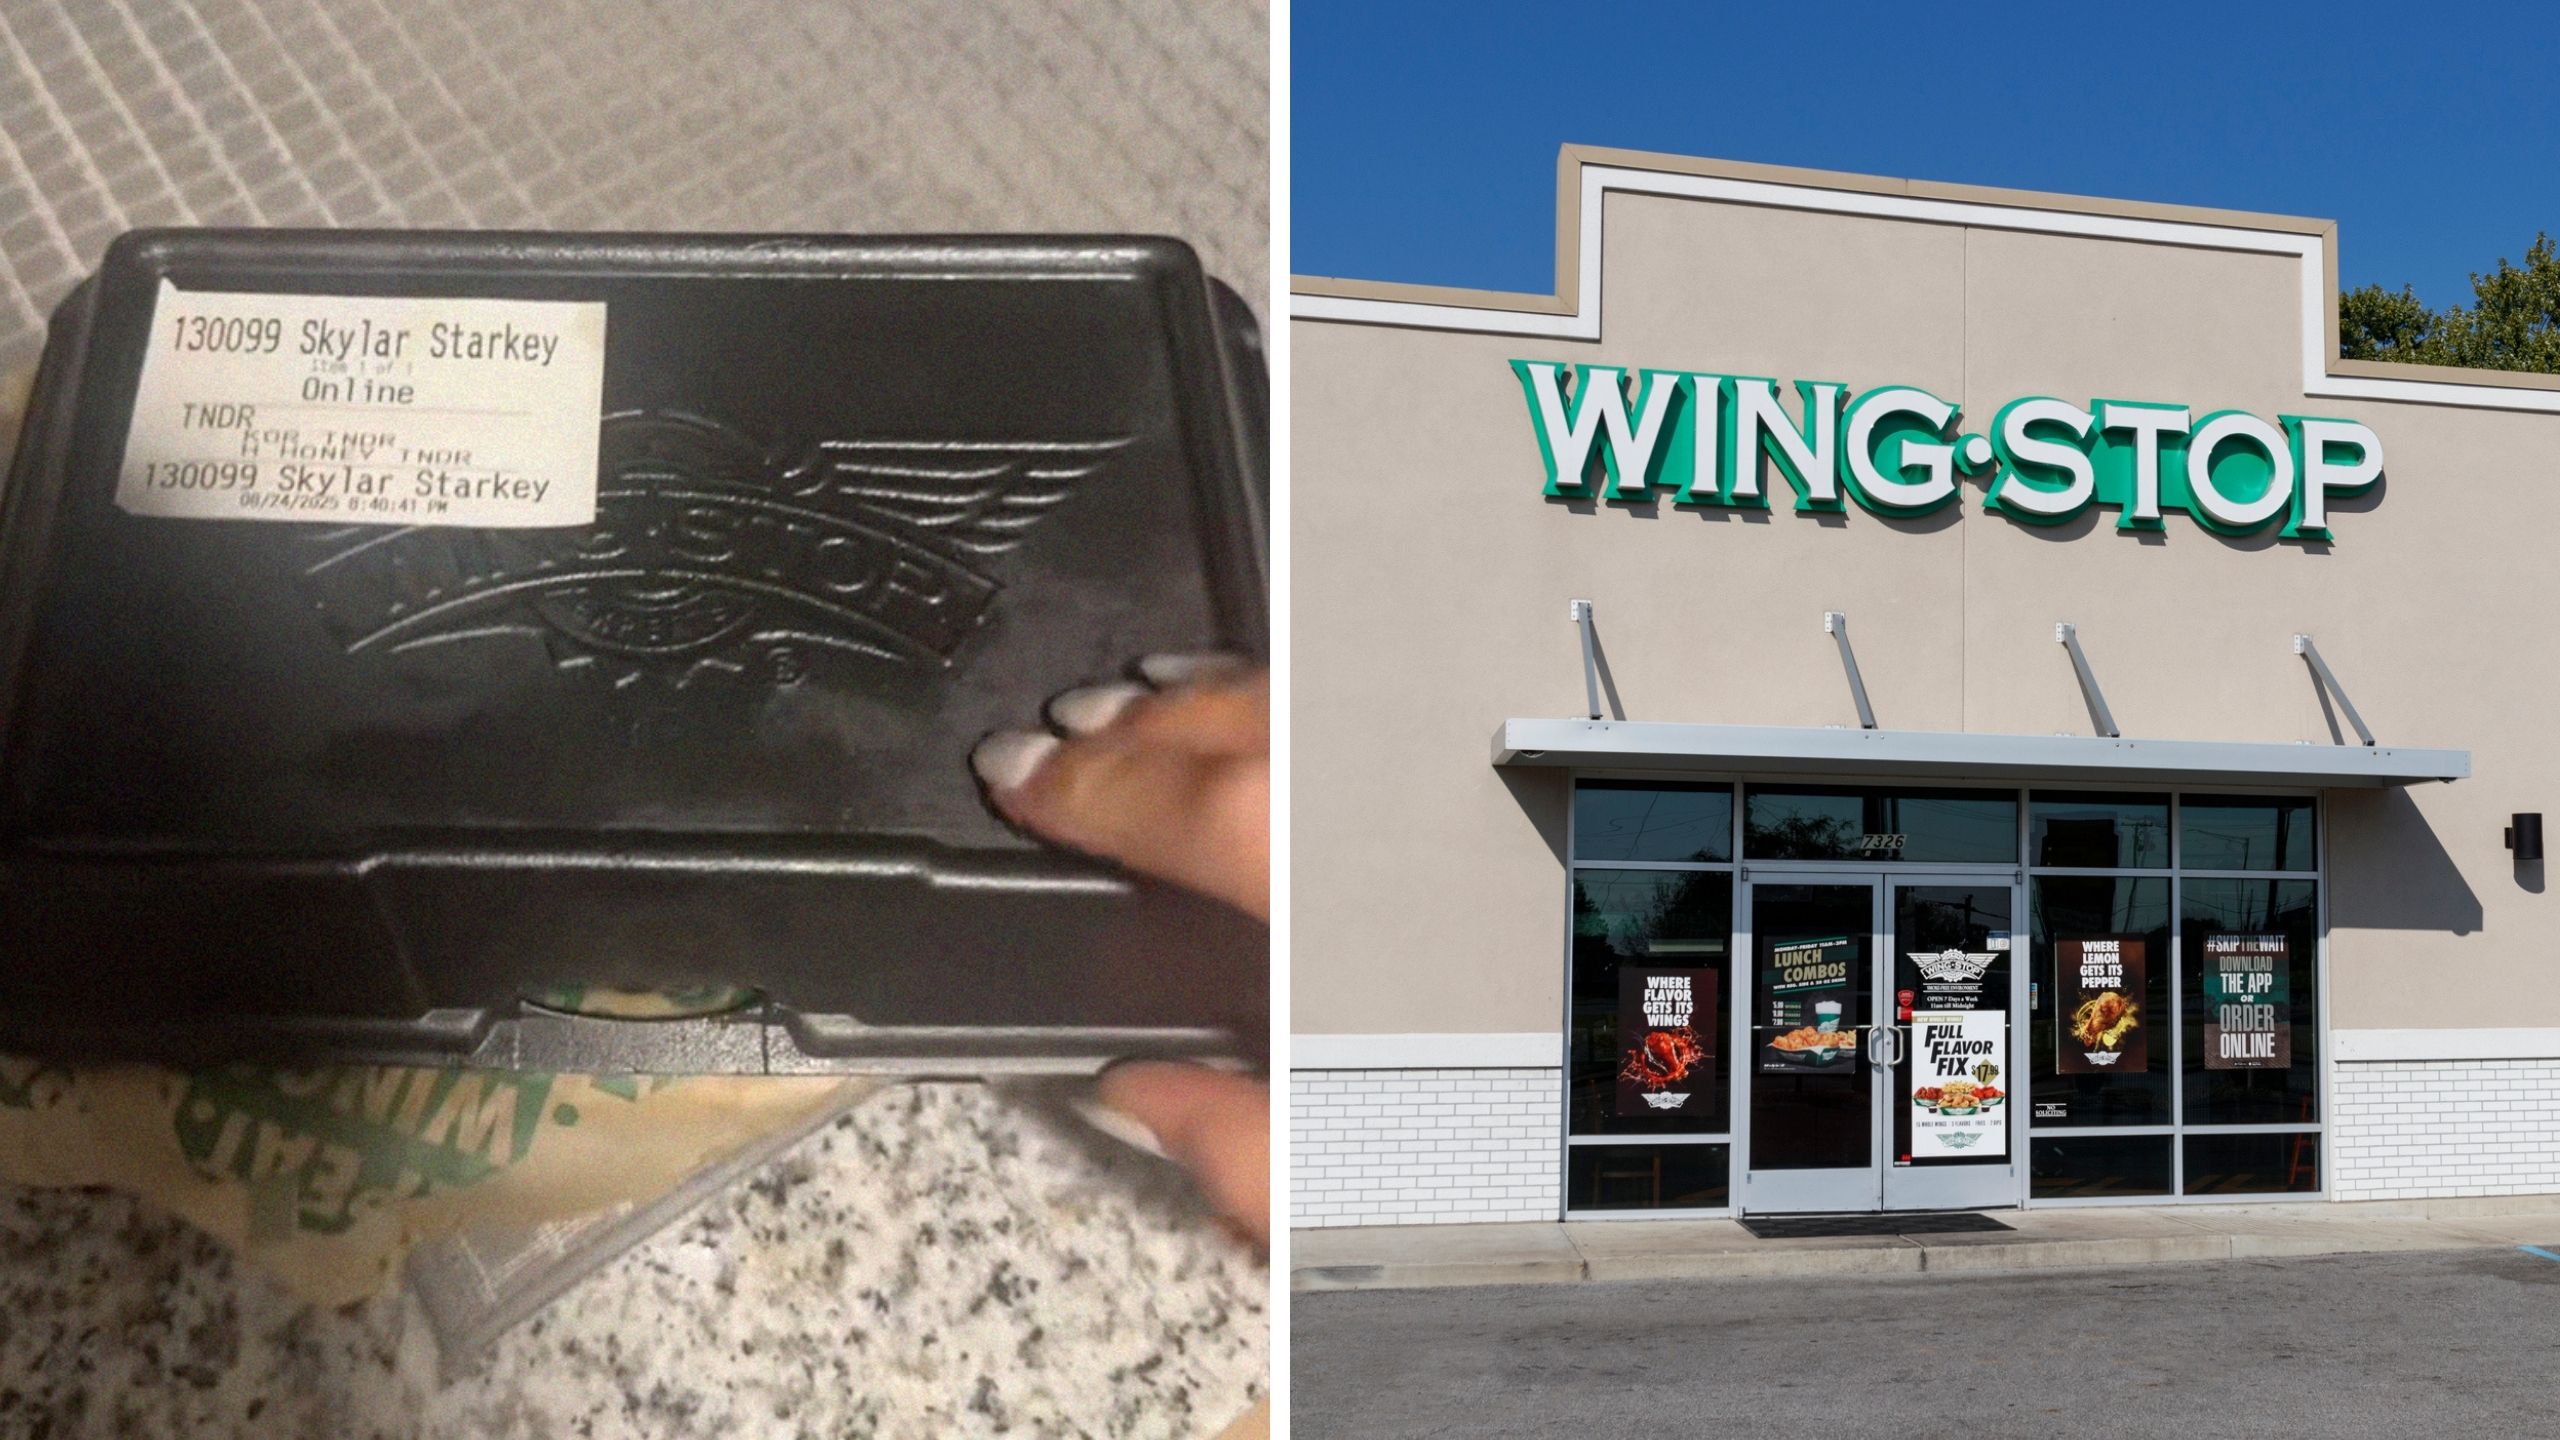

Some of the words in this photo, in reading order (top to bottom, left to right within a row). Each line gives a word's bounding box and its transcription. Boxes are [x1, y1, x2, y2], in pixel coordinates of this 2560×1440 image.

[174, 315, 282, 353] 130099
[300, 319, 411, 362] Skylar
[430, 323, 559, 366] Starkey
[302, 376, 415, 404] Online
[182, 403, 256, 430] TNDR
[144, 464, 258, 491] 130099
[278, 465, 394, 497] Skylar
[416, 469, 551, 503] Starkey
[1863, 835, 1905, 849] 7326
[2082, 941, 2120, 952] WHERE
[1774, 948, 1822, 968] LUNCH
[2082, 953, 2120, 964] LEMON
[2220, 956, 2273, 972] DOWNLOAD
[1783, 962, 1847, 983] COMBOS
[2080, 964, 2105, 976] GETS
[2107, 964, 2123, 976] ITS
[1646, 976, 1691, 989] WHERE
[2082, 976, 2122, 988] PEPPER
[2221, 973, 2244, 993] THE
[2248, 973, 2273, 993] APP
[1644, 989, 1692, 1001] FLAVOR
[2240, 995, 2255, 1003] OR
[1643, 1001, 1673, 1014] GETS
[1675, 1001, 1693, 1014] ITS
[1646, 1014, 1690, 1027] WINGS
[2220, 1004, 2276, 1032] ORDER
[1924, 1025, 1964, 1047] FULL
[1930, 1040, 1993, 1063] FLAVOR
[2220, 1033, 2276, 1059] ONLINE
[1936, 1057, 1969, 1076] FIX
